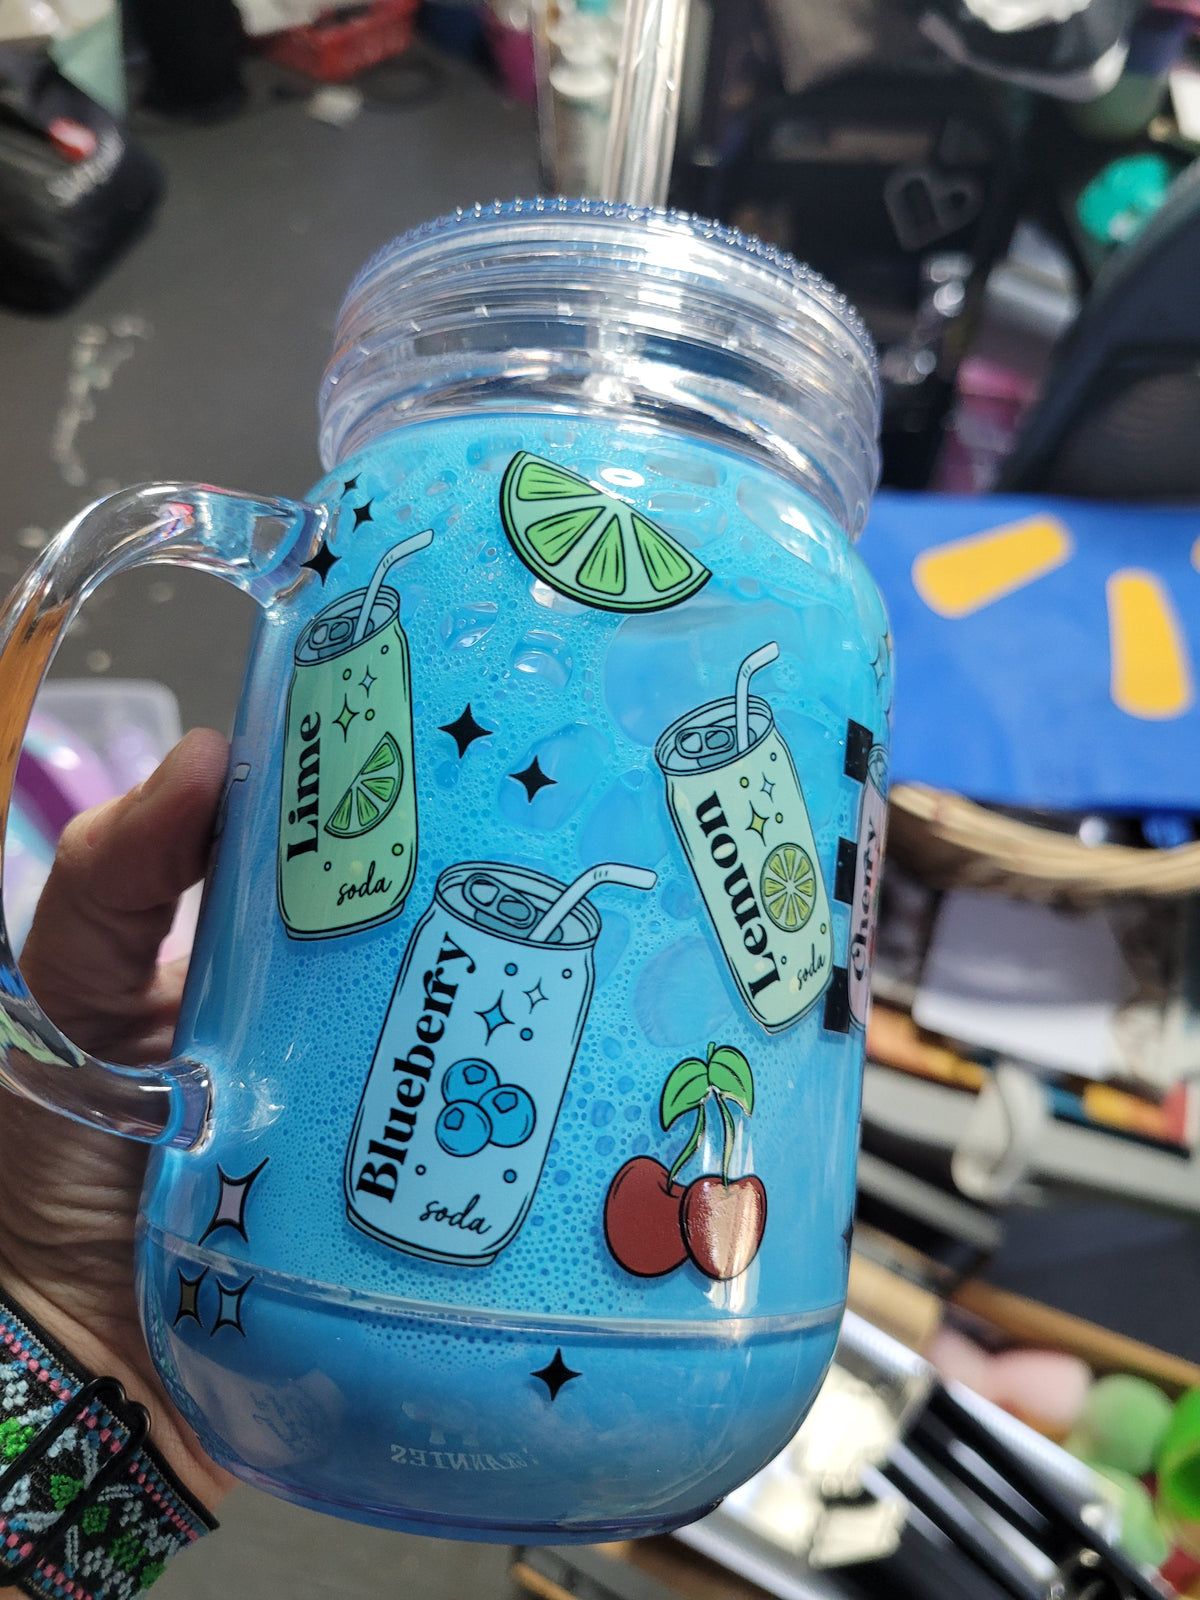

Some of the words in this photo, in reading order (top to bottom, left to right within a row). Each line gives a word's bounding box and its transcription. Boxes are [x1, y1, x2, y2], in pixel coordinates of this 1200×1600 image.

[287, 711, 321, 862] Lime
[337, 860, 393, 906] soda
[695, 790, 781, 999] Lemon
[796, 942, 825, 991] soda
[356, 931, 476, 1203] Blueberry
[419, 1194, 492, 1235] soda
